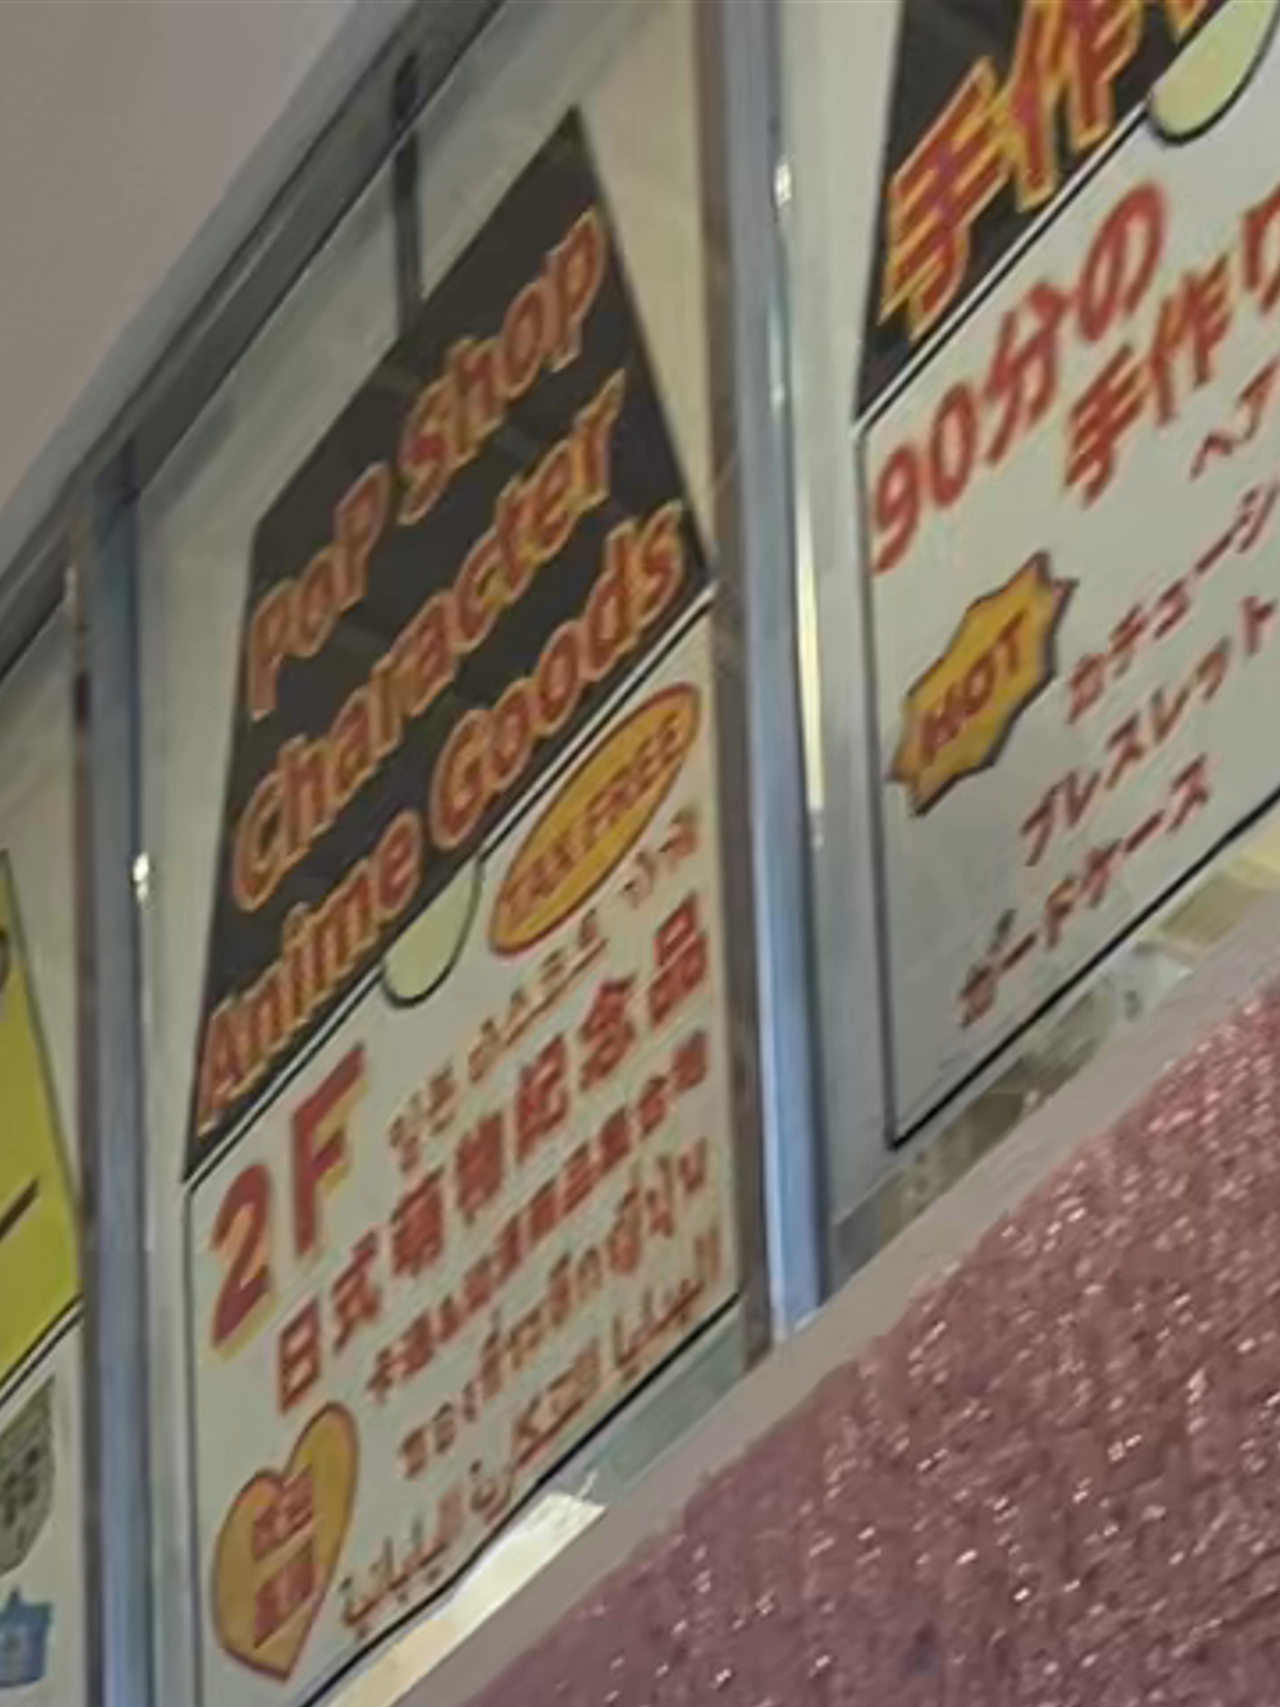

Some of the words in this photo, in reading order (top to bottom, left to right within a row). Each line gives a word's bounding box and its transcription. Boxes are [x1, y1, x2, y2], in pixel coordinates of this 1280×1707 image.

[877, 0, 1218, 343] 手作
[396, 208, 604, 527] Shop
[872, 183, 1166, 574] 90分の
[231, 368, 628, 911] Character
[922, 609, 1029, 765] HOT
[1021, 596, 1278, 866] ブレスレット
[193, 811, 426, 1139] Anime
[428, 501, 687, 851] Goods
[210, 1042, 367, 1355] 2F
